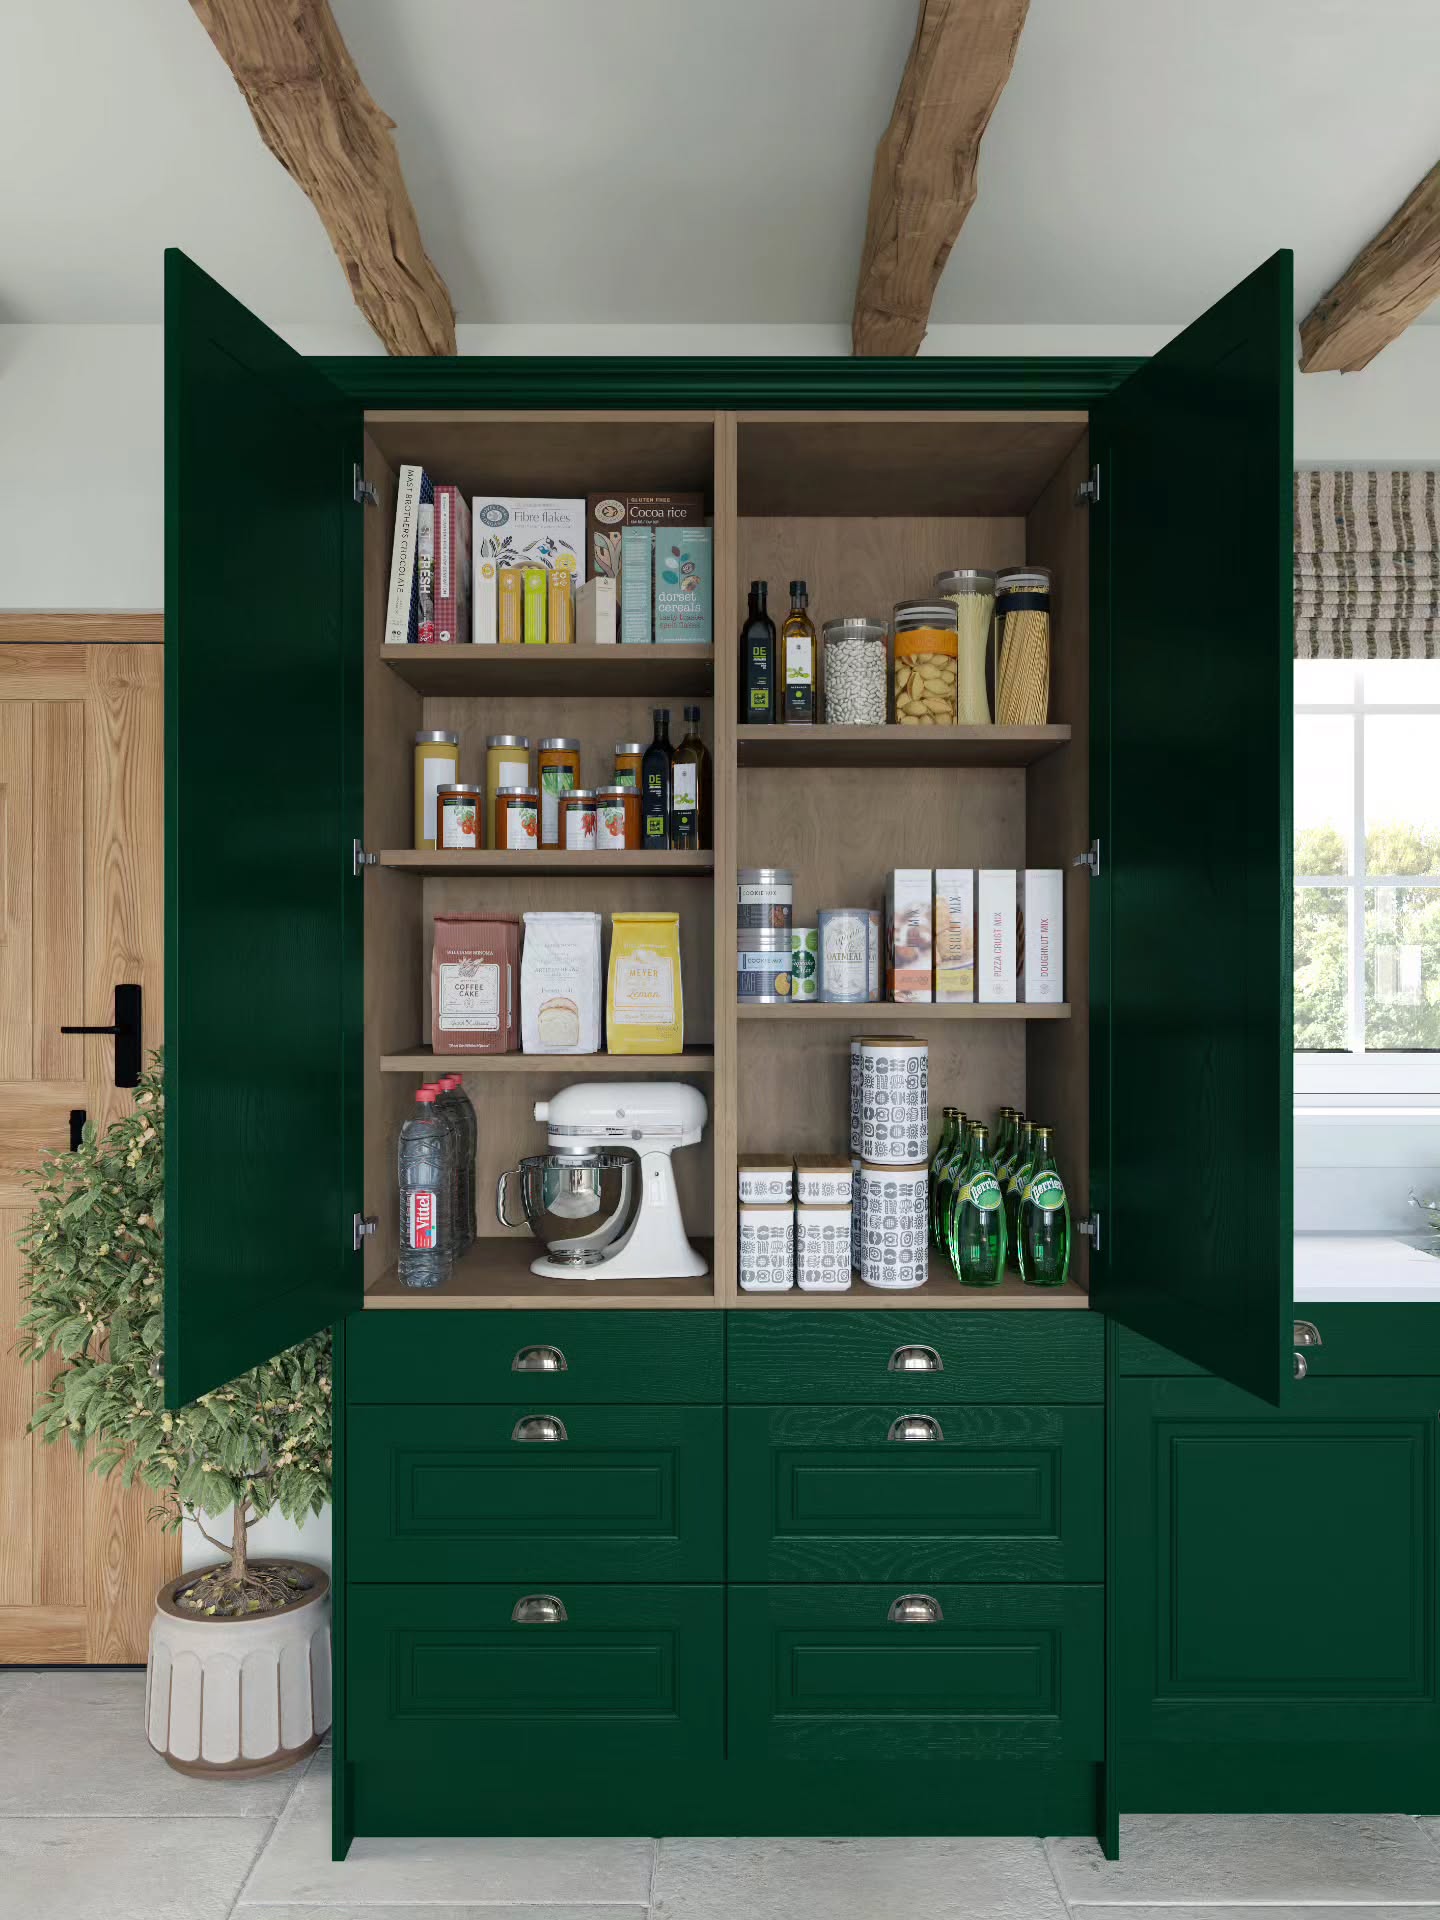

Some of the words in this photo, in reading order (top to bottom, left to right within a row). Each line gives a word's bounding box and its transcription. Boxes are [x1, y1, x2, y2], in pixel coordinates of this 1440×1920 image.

[406, 469, 415, 492] MAST
[402, 493, 413, 539] BROTHERS
[514, 511, 540, 522] Fibre
[542, 511, 571, 522] flakes
[630, 506, 664, 518] Cocoa
[667, 506, 687, 518] rice
[397, 539, 408, 593] CHOCOLATE
[658, 591, 697, 602] dorset
[658, 603, 701, 613] cereals
[753, 646, 767, 655] DE
[649, 774, 662, 783] DE
[949, 896, 962, 914] MIX
[908, 909, 920, 927] MIX
[993, 912, 1002, 927] MIX
[1040, 918, 1049, 933] MIX
[949, 922, 962, 961] BISCUIT
[993, 929, 1002, 954] CRUST
[826, 952, 863, 961] OATMEAL
[1040, 934, 1049, 977] DOUGHNUT
[629, 968, 658, 977] MEYER
[993, 956, 1002, 977] PIZZA
[454, 983, 484, 991] COFFEE
[970, 1177, 1000, 1205] Perrier
[1030, 1177, 1064, 1205] Perrier
[416, 1195, 430, 1230] Vittel
